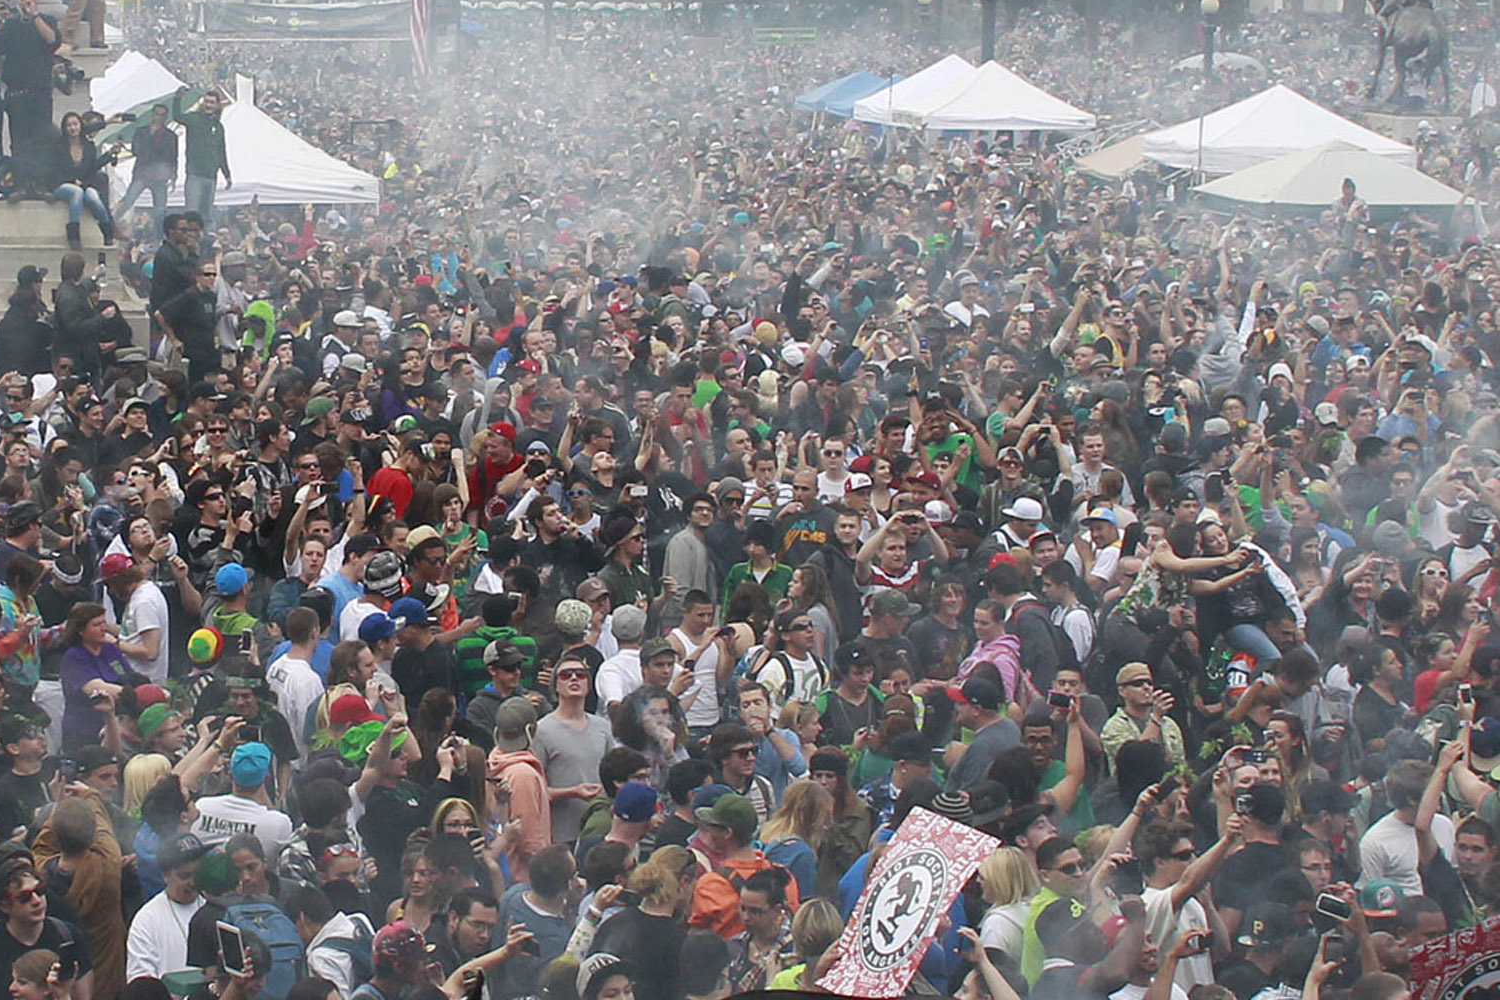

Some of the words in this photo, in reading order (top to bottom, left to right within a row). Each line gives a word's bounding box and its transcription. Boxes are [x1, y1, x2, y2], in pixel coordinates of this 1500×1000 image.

[200, 814, 257, 835] MAGNUM
[917, 853, 942, 907] SOCIETY
[866, 934, 919, 967] ANGELES
